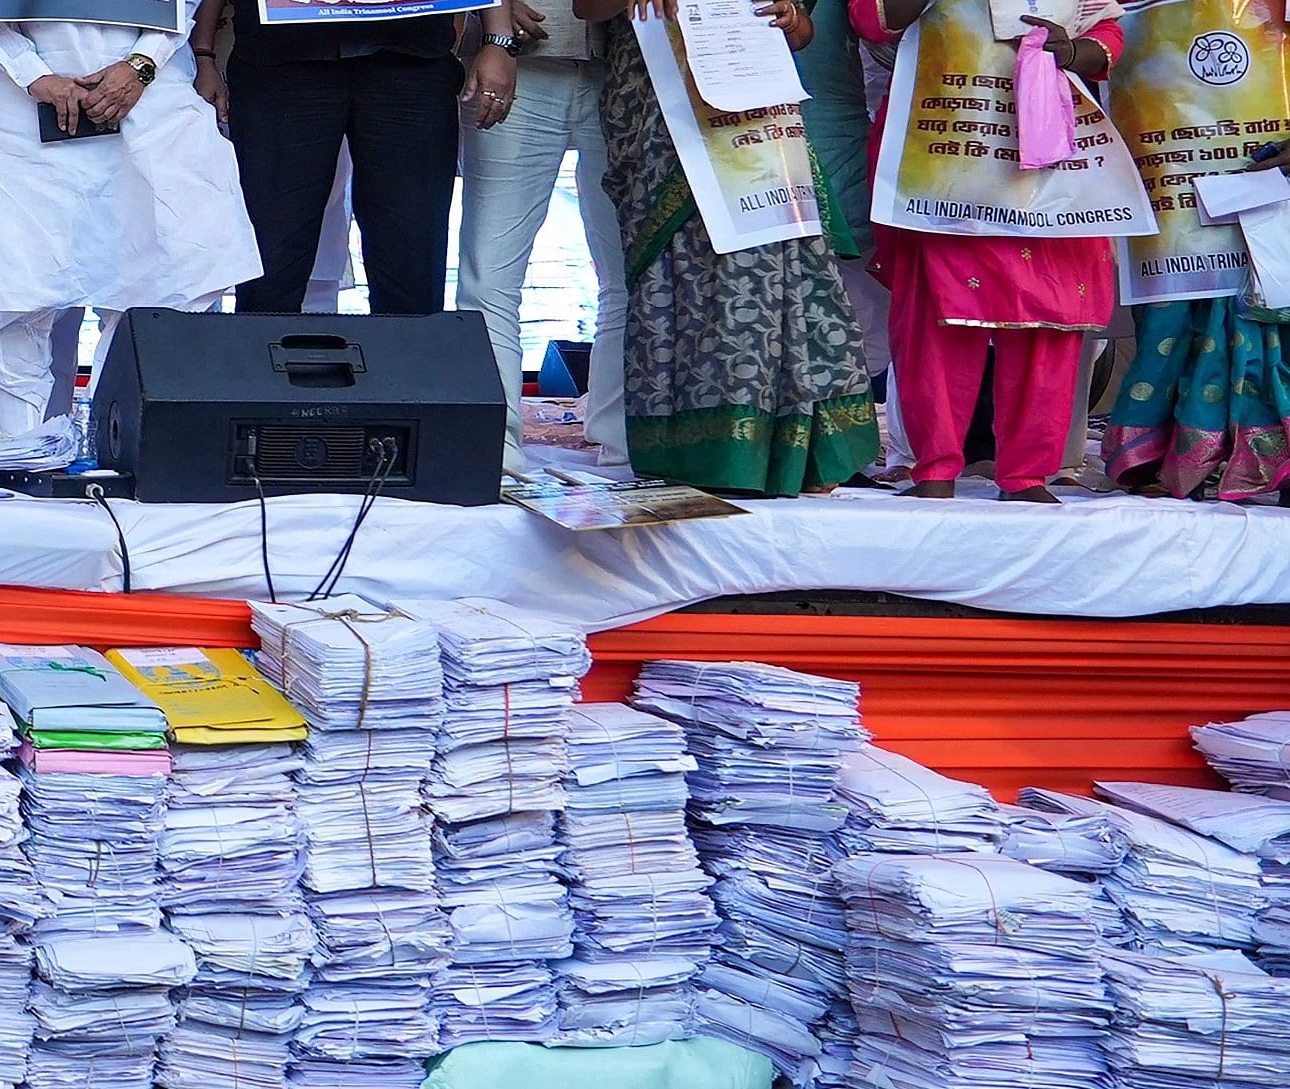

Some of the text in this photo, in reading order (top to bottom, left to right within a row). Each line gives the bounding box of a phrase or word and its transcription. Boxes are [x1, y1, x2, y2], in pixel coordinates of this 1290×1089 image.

[318, 4, 434, 16] All India Trinamool Congress
[942, 73, 967, 89] ঘর
[952, 120, 1012, 137] ফেরাও
[1139, 130, 1166, 146] ঘর
[1171, 119, 1240, 140] ছেড়েছি
[1244, 118, 1280, 134] বাধ্য
[928, 140, 961, 156] নেই
[964, 140, 990, 158] কি
[1095, 156, 1105, 168] ?
[1200, 147, 1238, 161] ১০০
[740, 194, 765, 213] ALL
[906, 198, 1133, 228] ALL INDIA TRINAMOOL CONGRESS
[1141, 257, 1163, 277] ALL
[1166, 255, 1206, 274] INDIA
